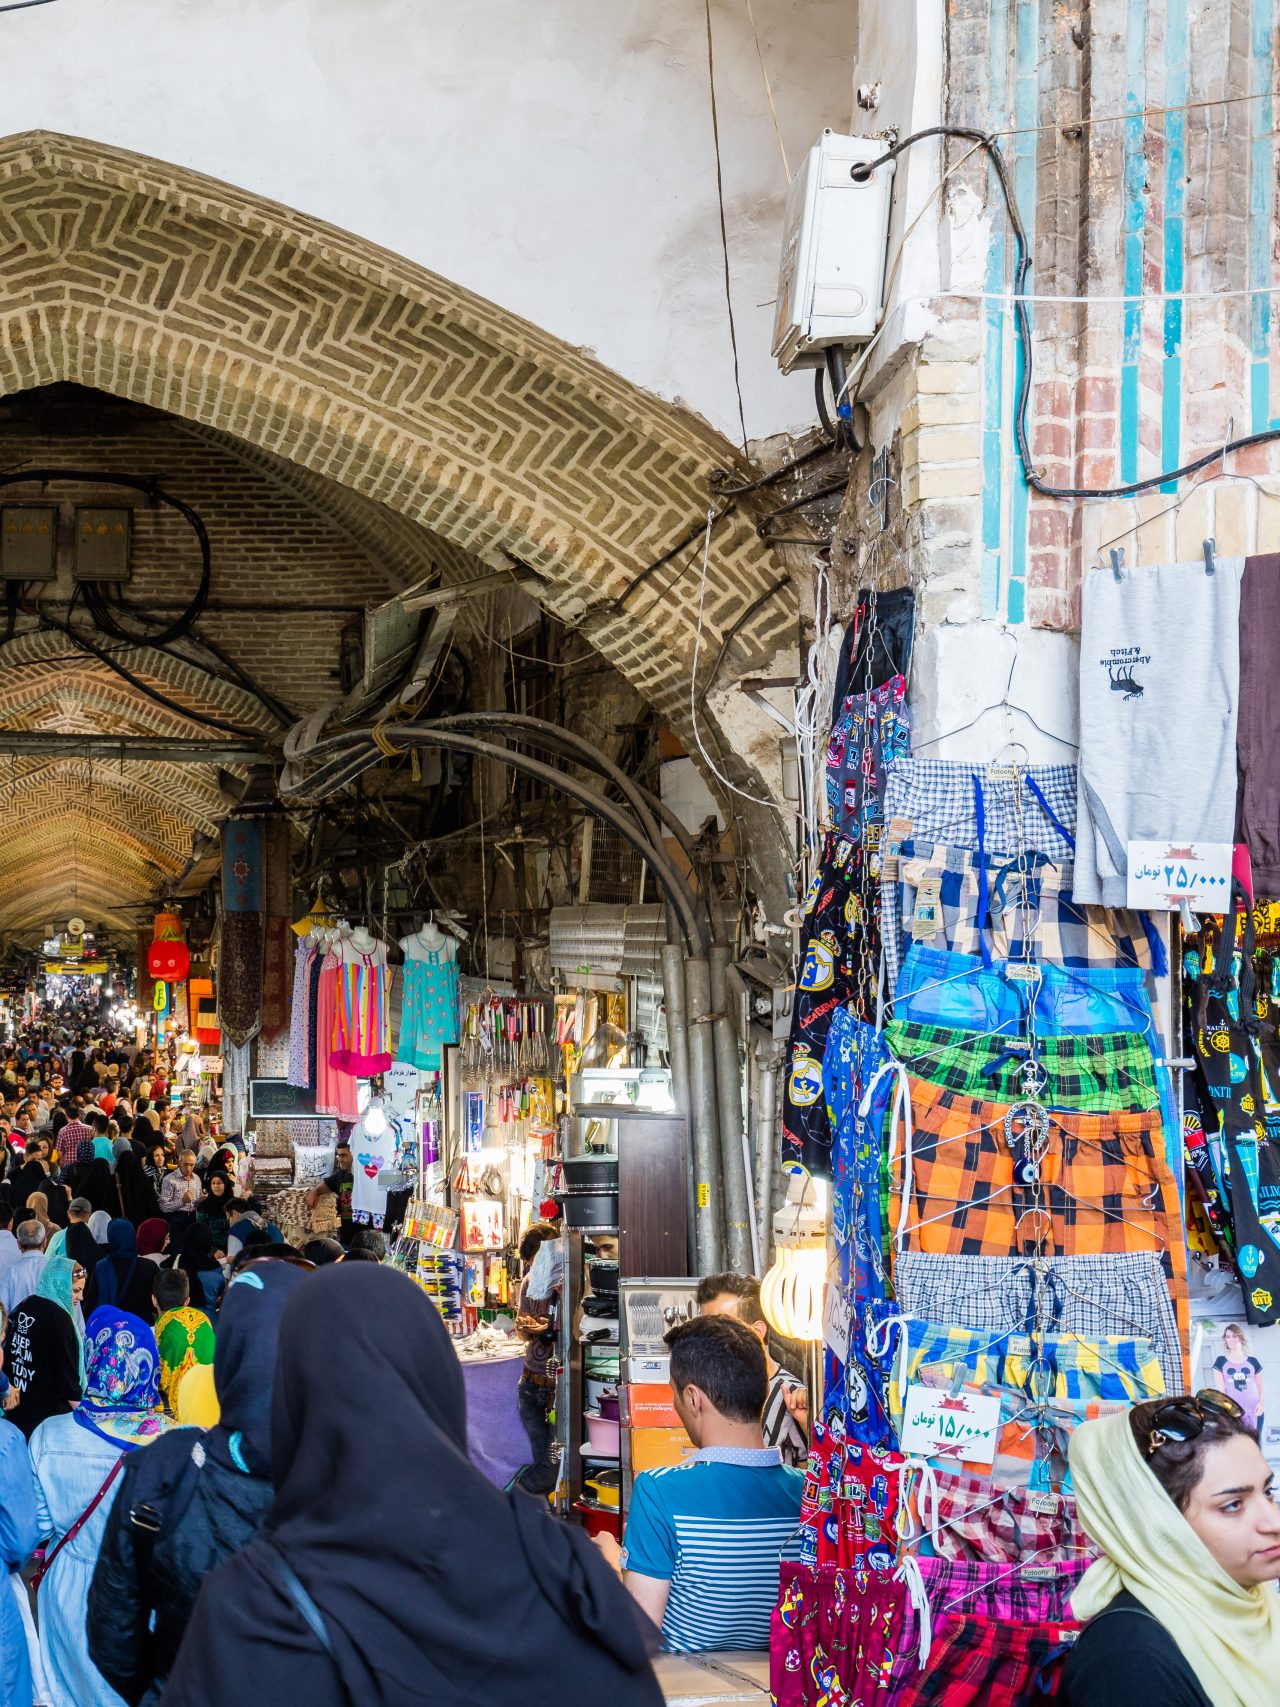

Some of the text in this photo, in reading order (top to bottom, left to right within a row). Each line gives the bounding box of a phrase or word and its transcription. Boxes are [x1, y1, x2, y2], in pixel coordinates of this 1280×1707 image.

[1100, 656, 1151, 667] Abercrombie
[1135, 864, 1160, 880] تومان
[11, 1361, 35, 1381] TUDY
[13, 1376, 28, 1393] ON
[912, 1411, 936, 1428] تومان
[1024, 1569, 1050, 1577] Fotoohy
